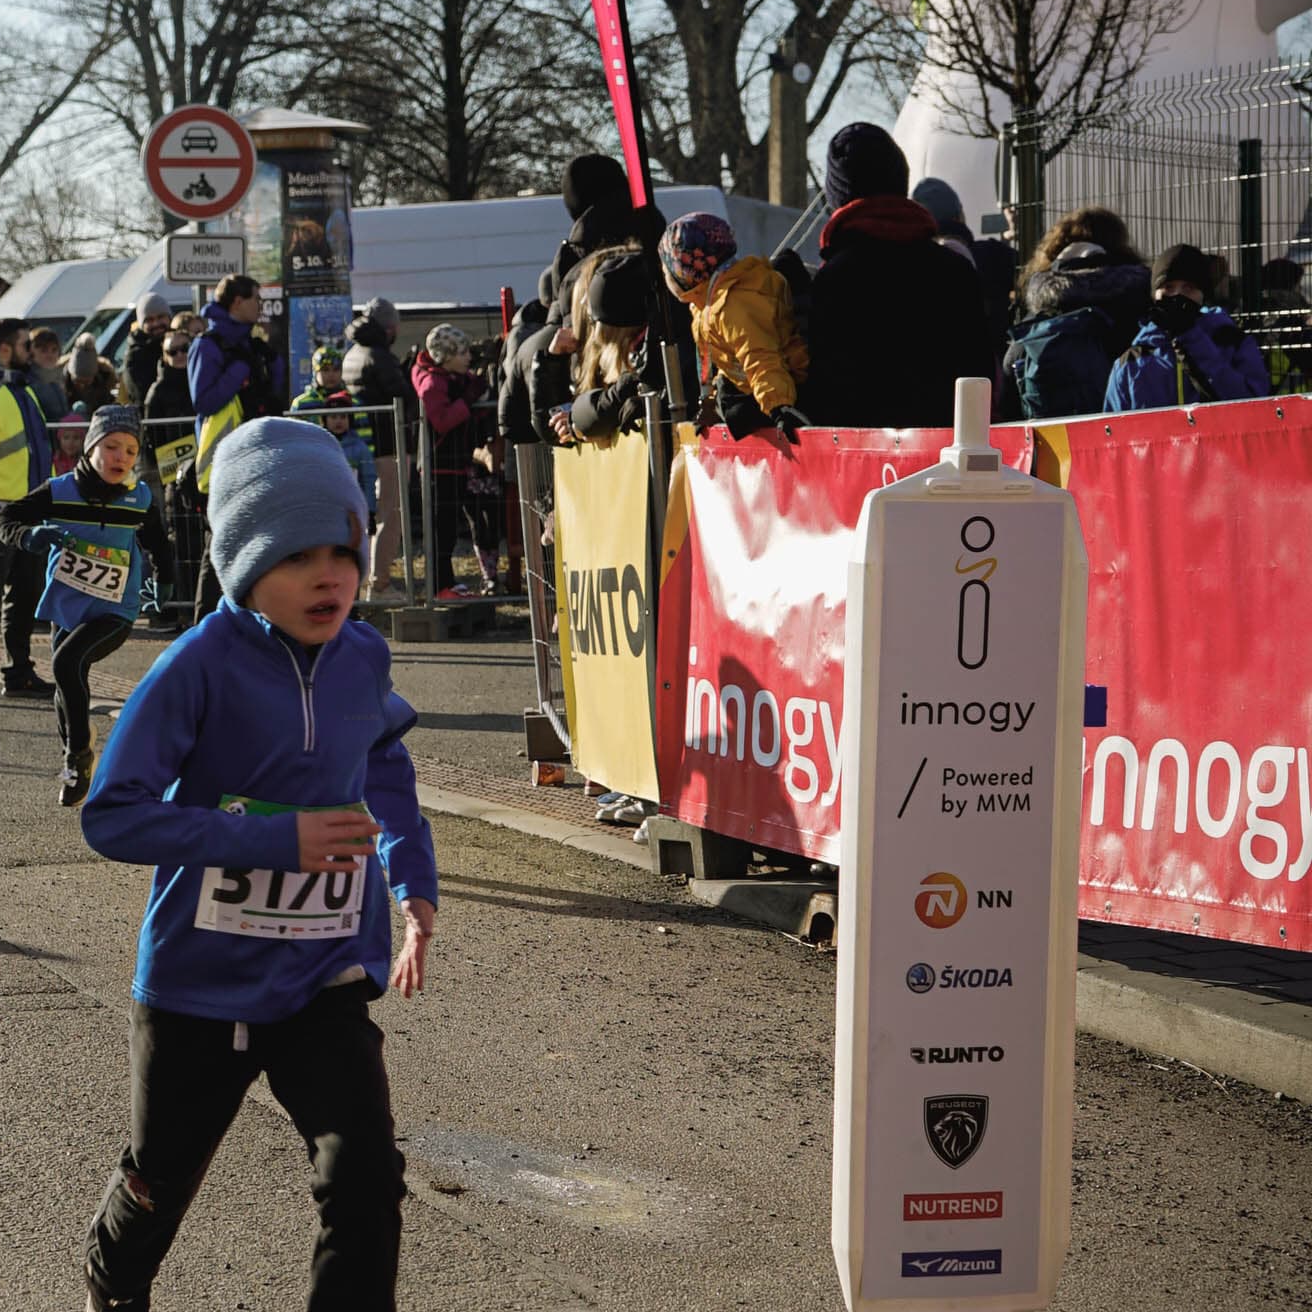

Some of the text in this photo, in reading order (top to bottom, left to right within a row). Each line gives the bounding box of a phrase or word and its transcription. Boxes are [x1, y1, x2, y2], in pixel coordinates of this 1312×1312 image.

[192, 243, 221, 257] MIMO
[60, 551, 123, 590] 3273
[901, 692, 1036, 733] innogy
[685, 645, 845, 807] innogy
[942, 765, 1033, 787] Powered
[941, 793, 1031, 818] by MVM
[977, 890, 1013, 909] NN
[939, 965, 1013, 989] ŠKODA
[928, 1045, 1005, 1064] RUNTO
[909, 1198, 999, 1216] NUTREND
